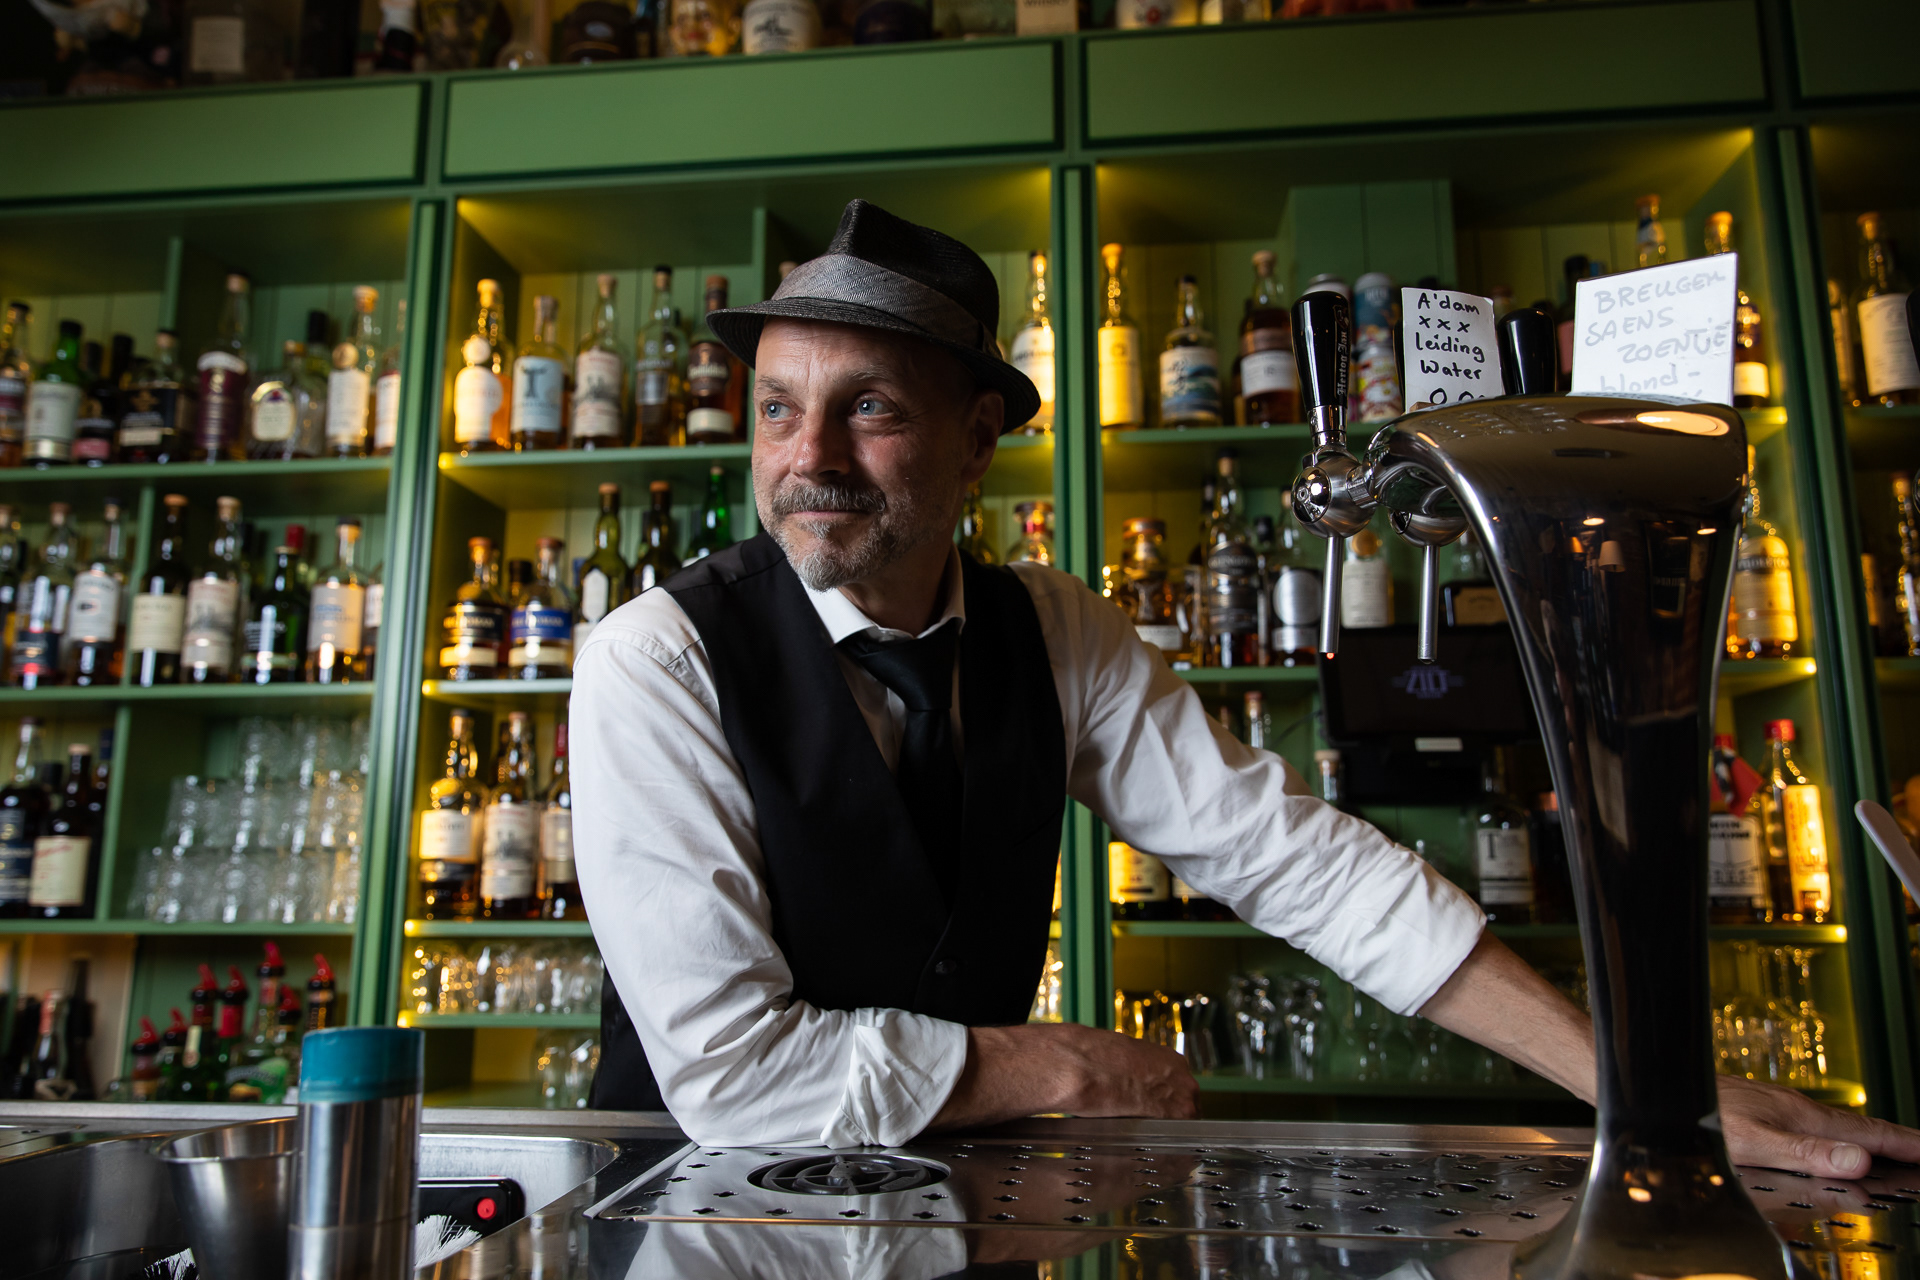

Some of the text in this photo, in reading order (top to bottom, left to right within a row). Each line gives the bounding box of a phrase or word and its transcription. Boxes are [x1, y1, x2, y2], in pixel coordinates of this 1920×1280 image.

[1418, 292, 1480, 315] A'dam
[1585, 307, 1674, 347] SAENS
[1416, 332, 1485, 363] leiding
[1337, 331, 1348, 396] Hertog Jan
[1600, 362, 1678, 392] blond
